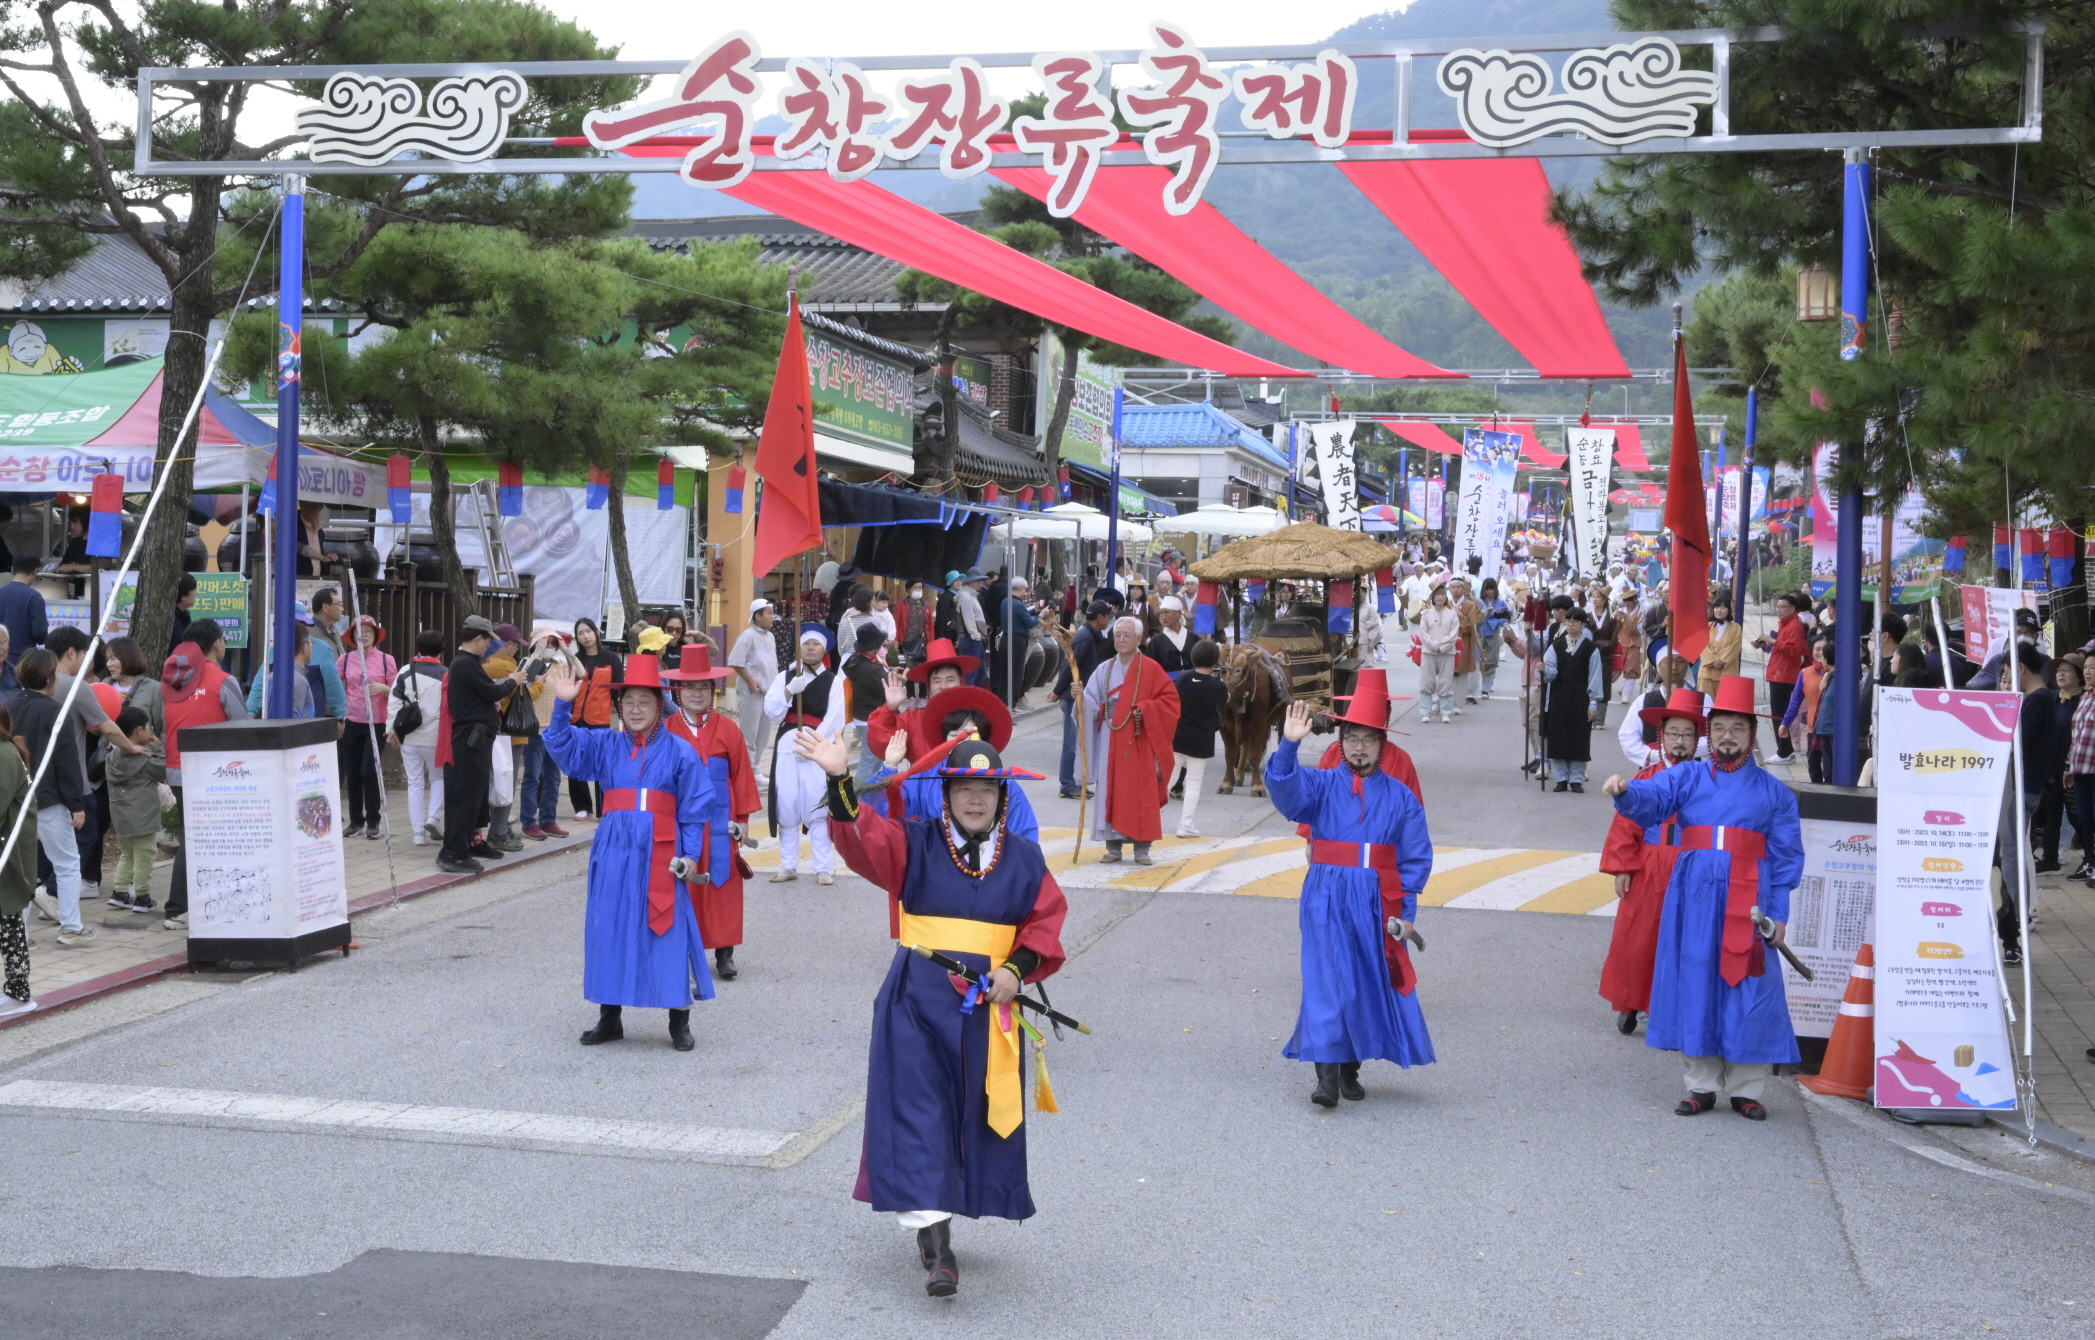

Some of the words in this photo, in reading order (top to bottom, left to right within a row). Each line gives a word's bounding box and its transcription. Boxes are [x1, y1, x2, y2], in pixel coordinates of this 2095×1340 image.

[588, 24, 1350, 213] 순창장류축제
[352, 470, 366, 498] 빵
[1491, 516, 1506, 549] 오세요
[197, 580, 245, 594] 인머스켓
[1899, 752, 1956, 770] 발효나라
[1961, 756, 1994, 769] 1997
